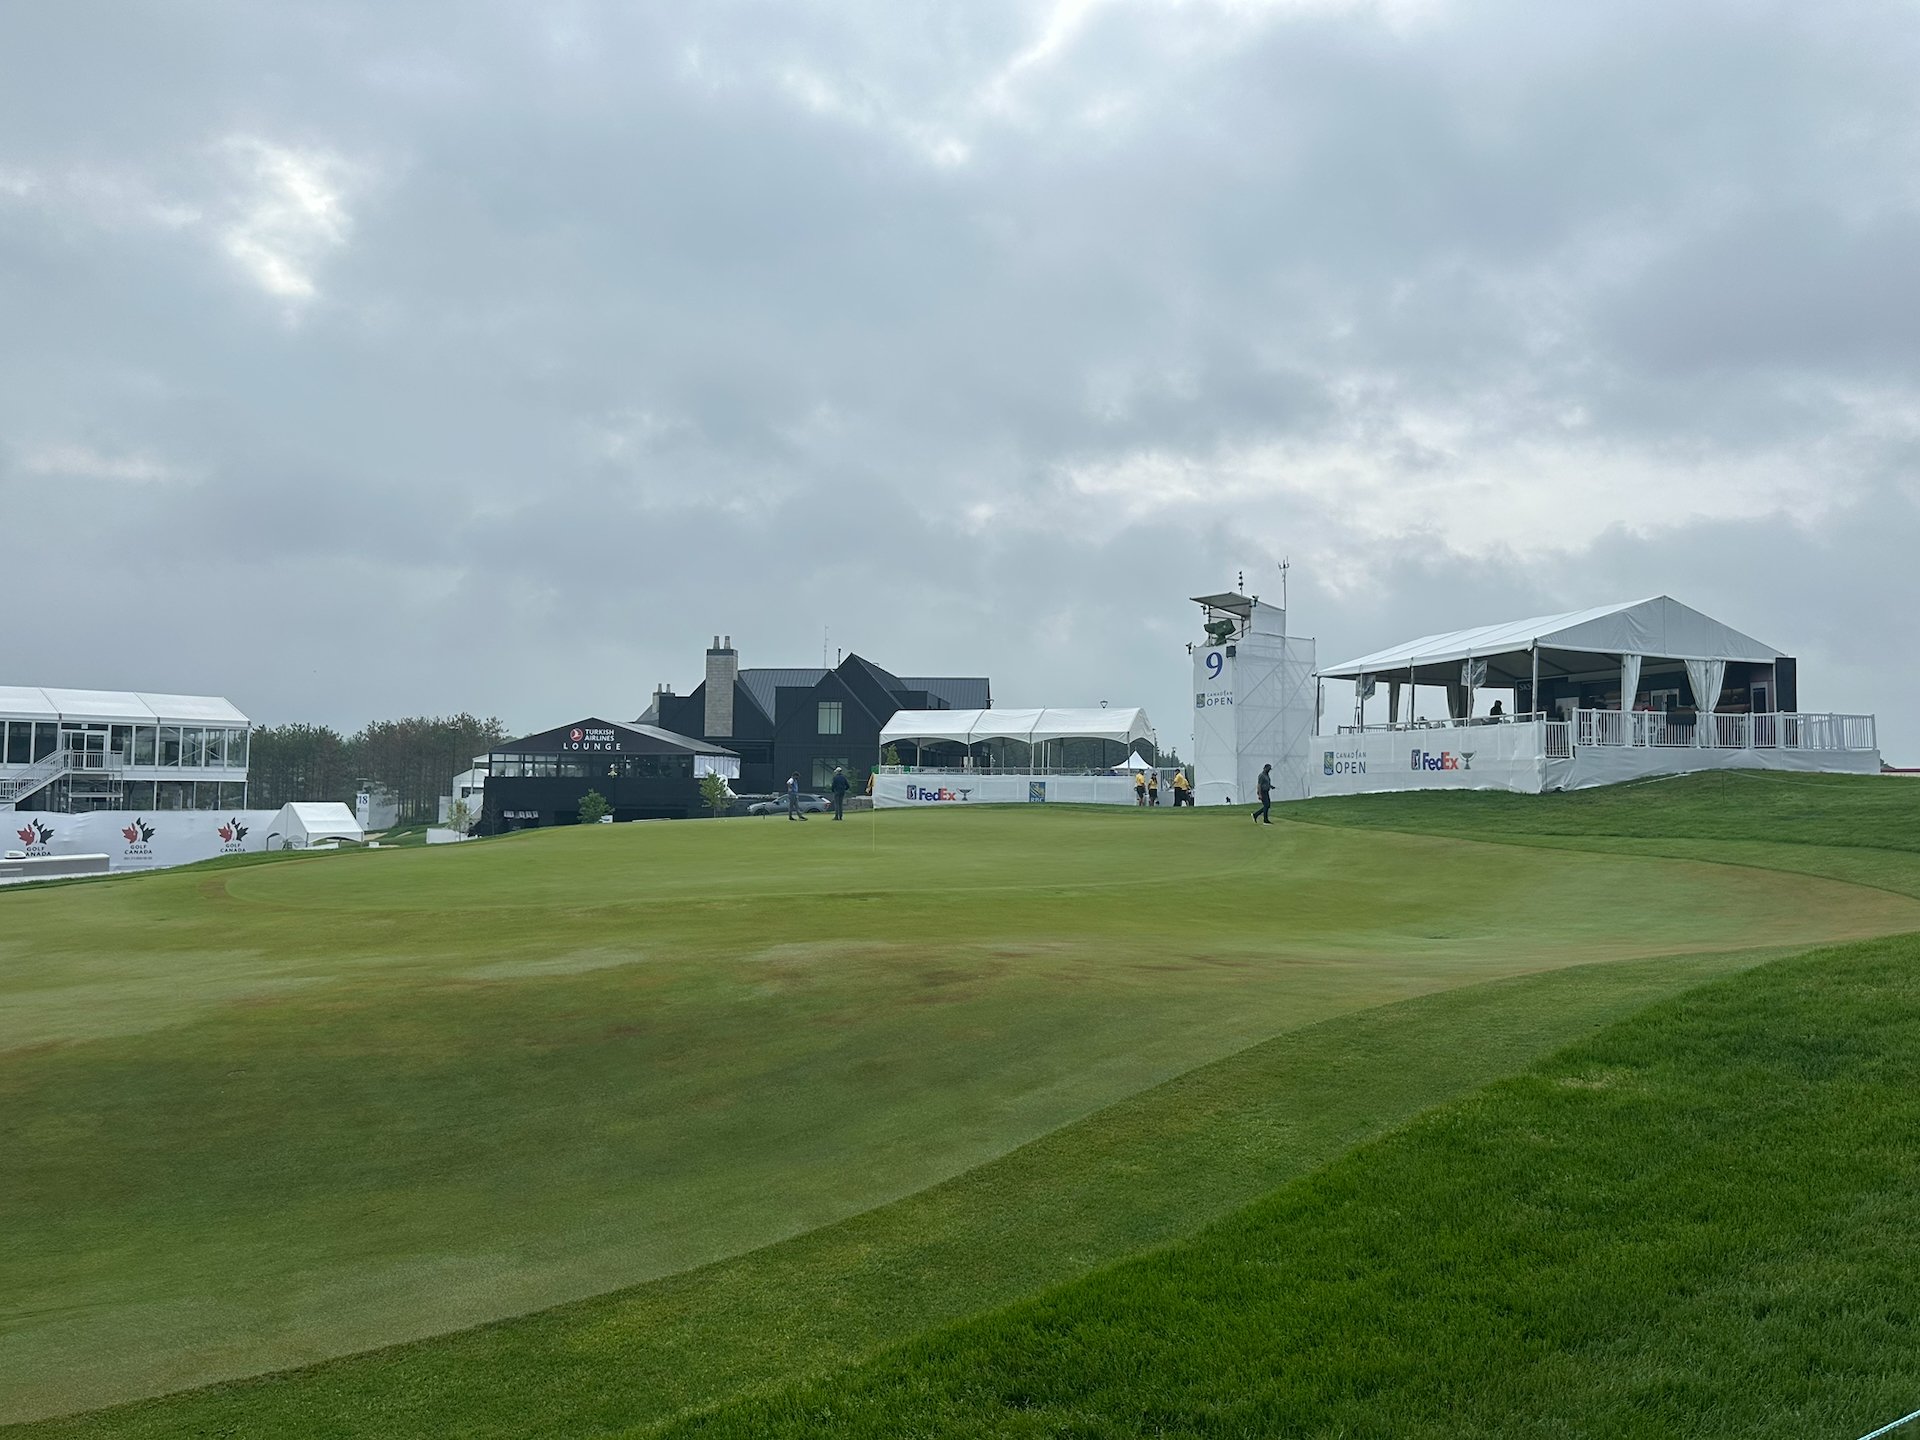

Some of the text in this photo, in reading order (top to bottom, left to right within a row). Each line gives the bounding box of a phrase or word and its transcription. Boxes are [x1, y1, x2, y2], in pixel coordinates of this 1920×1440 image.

[1206, 652, 1223, 680] 9
[1206, 697, 1233, 706] OPEN
[563, 742, 621, 750] LOUNGE
[1335, 749, 1367, 759] CANADIAN
[1422, 751, 1459, 771] FedEx
[1335, 761, 1366, 774] OPEN
[919, 787, 956, 801] FedEx
[358, 795, 368, 805] 18
